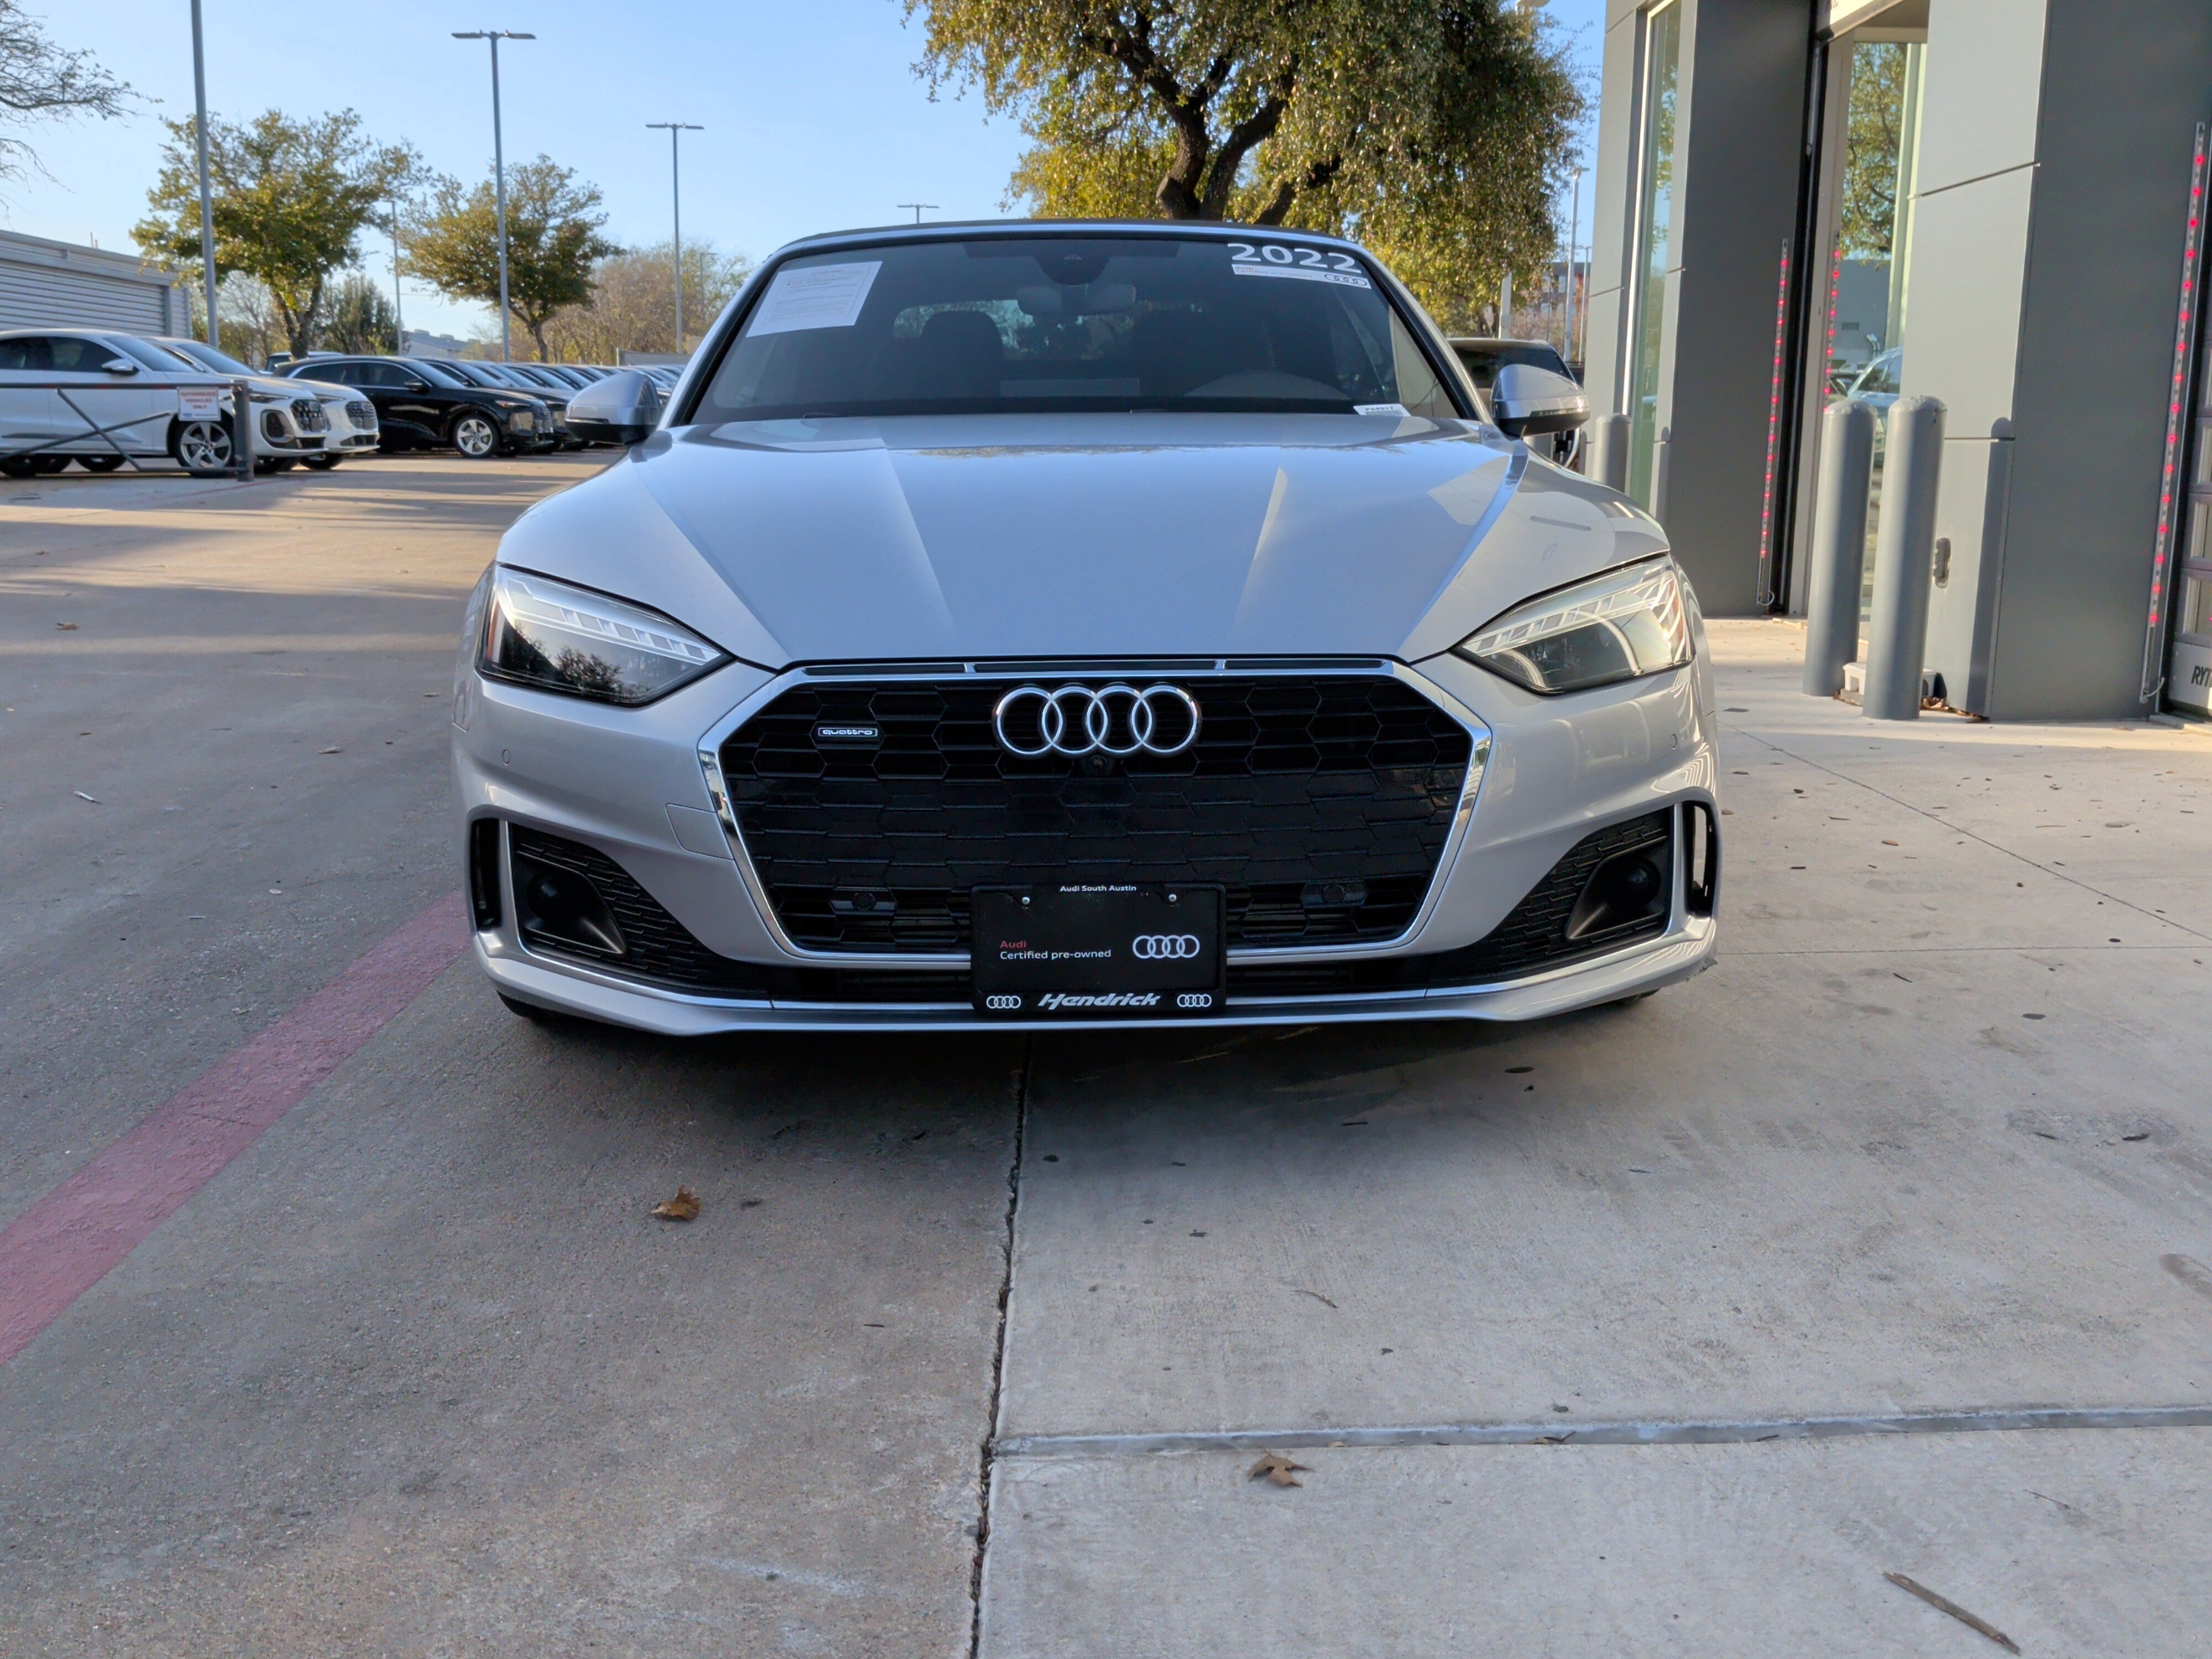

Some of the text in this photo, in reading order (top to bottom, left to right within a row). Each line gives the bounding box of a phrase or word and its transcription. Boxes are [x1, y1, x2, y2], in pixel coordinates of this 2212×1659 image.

[1227, 243, 1362, 274] 2022
[1000, 940, 1026, 948] Audi
[1000, 950, 1112, 960] Certified pre-owned
[1037, 993, 1161, 1010] Hendrick
